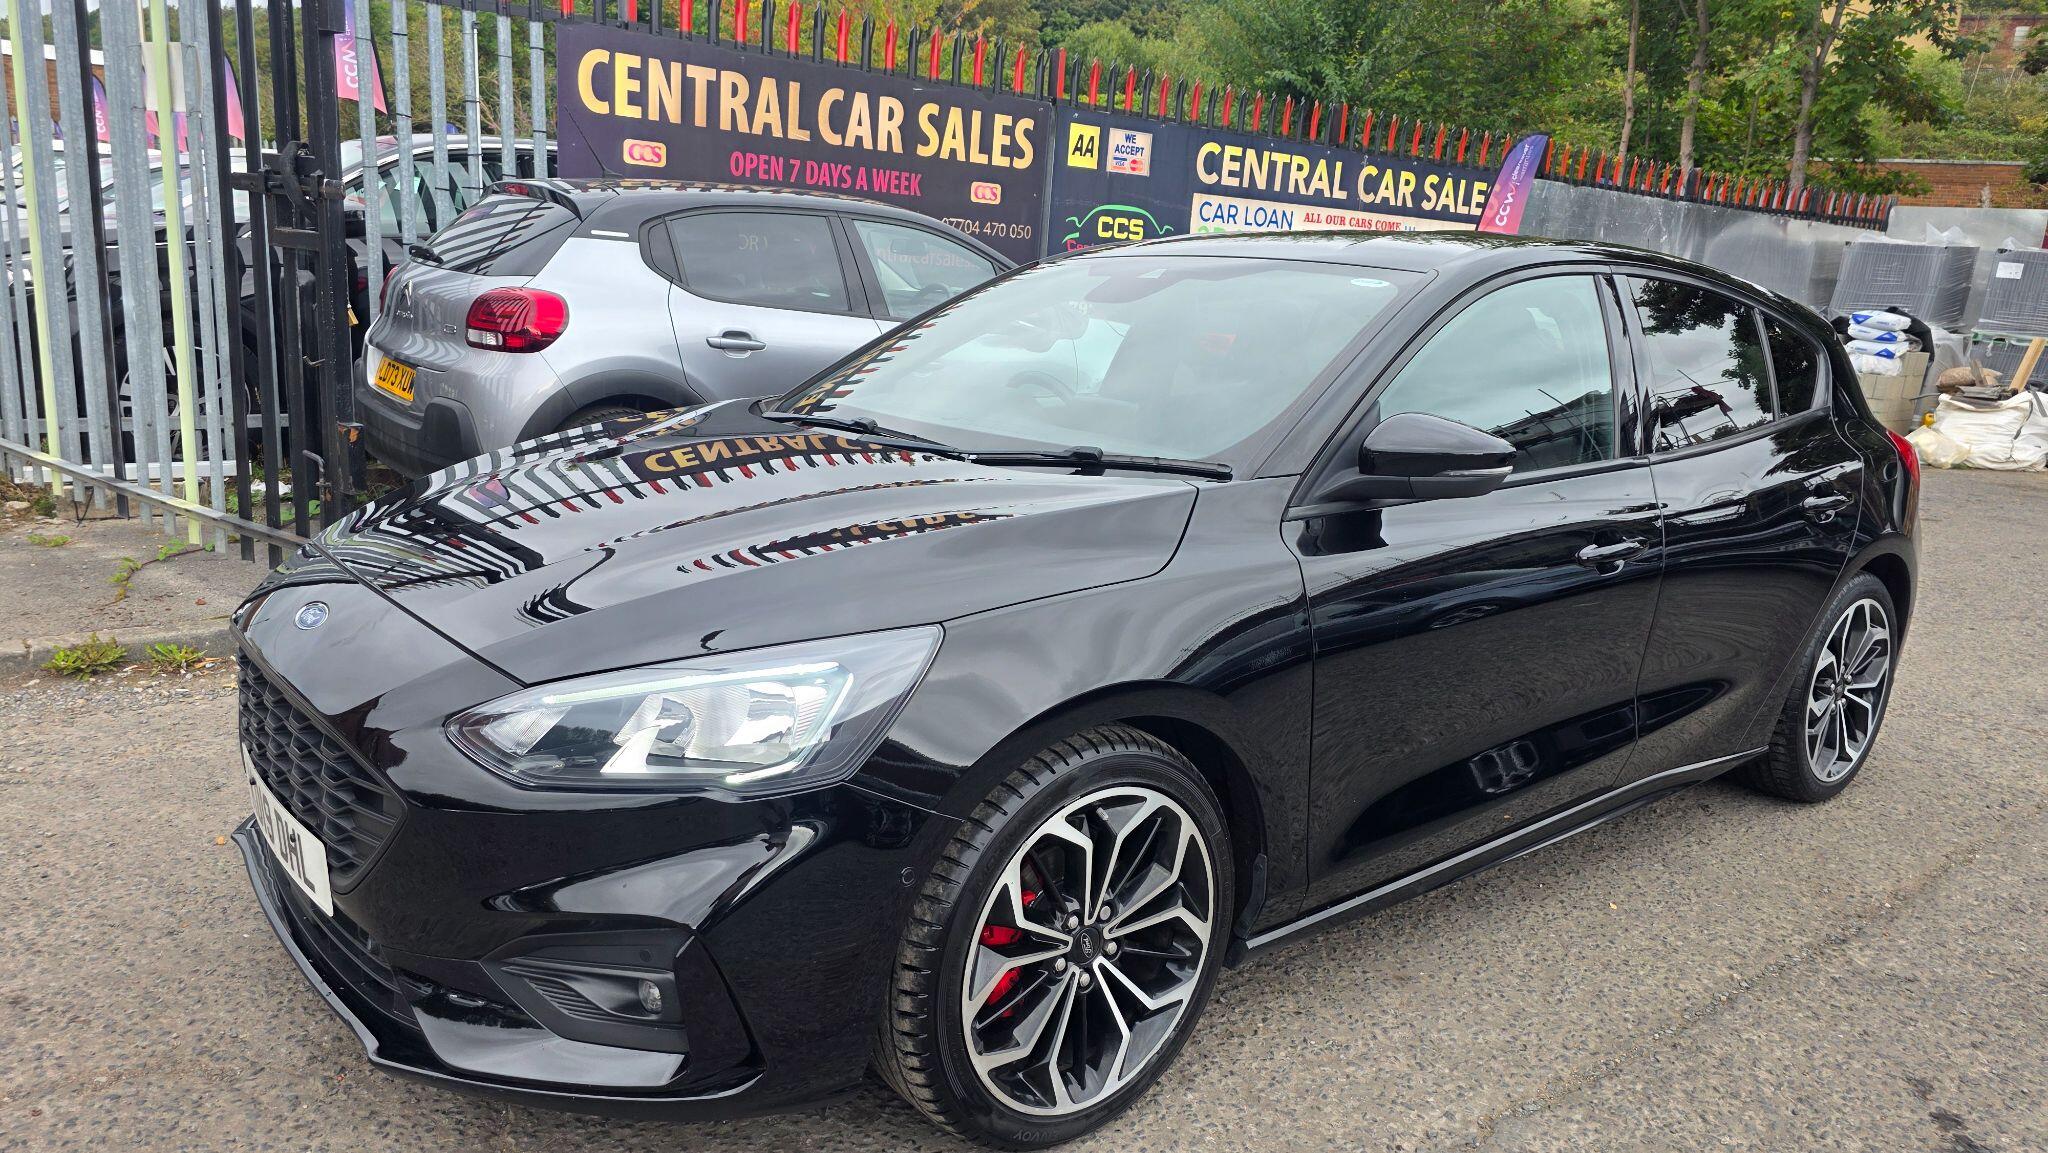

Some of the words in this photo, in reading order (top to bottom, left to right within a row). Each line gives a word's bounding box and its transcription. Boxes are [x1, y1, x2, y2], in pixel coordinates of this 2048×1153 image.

[577, 48, 811, 142] CENTRAL
[817, 87, 905, 154] CAR
[916, 102, 1035, 170] SALES
[1071, 133, 1095, 158] AA
[1114, 143, 1145, 157] ACCEPT
[1124, 133, 1137, 144] WE
[730, 151, 784, 182] OPEN
[789, 158, 801, 183] 7
[805, 160, 852, 189] DAYS
[855, 166, 868, 191] A
[872, 168, 922, 197] WEEK
[1196, 141, 1348, 200] CENTRAL
[1357, 165, 1416, 208] CAR
[1422, 173, 1492, 216] SALE
[1097, 215, 1144, 240] CCS
[1199, 201, 1239, 225] CAR
[1244, 205, 1294, 230] LOAN
[1303, 212, 1322, 224] ALL
[1325, 214, 1346, 227] OUR
[1349, 217, 1373, 230] CARS
[1375, 220, 1402, 231] COME
[983, 221, 1006, 237] 470
[1009, 223, 1032, 240] 050
